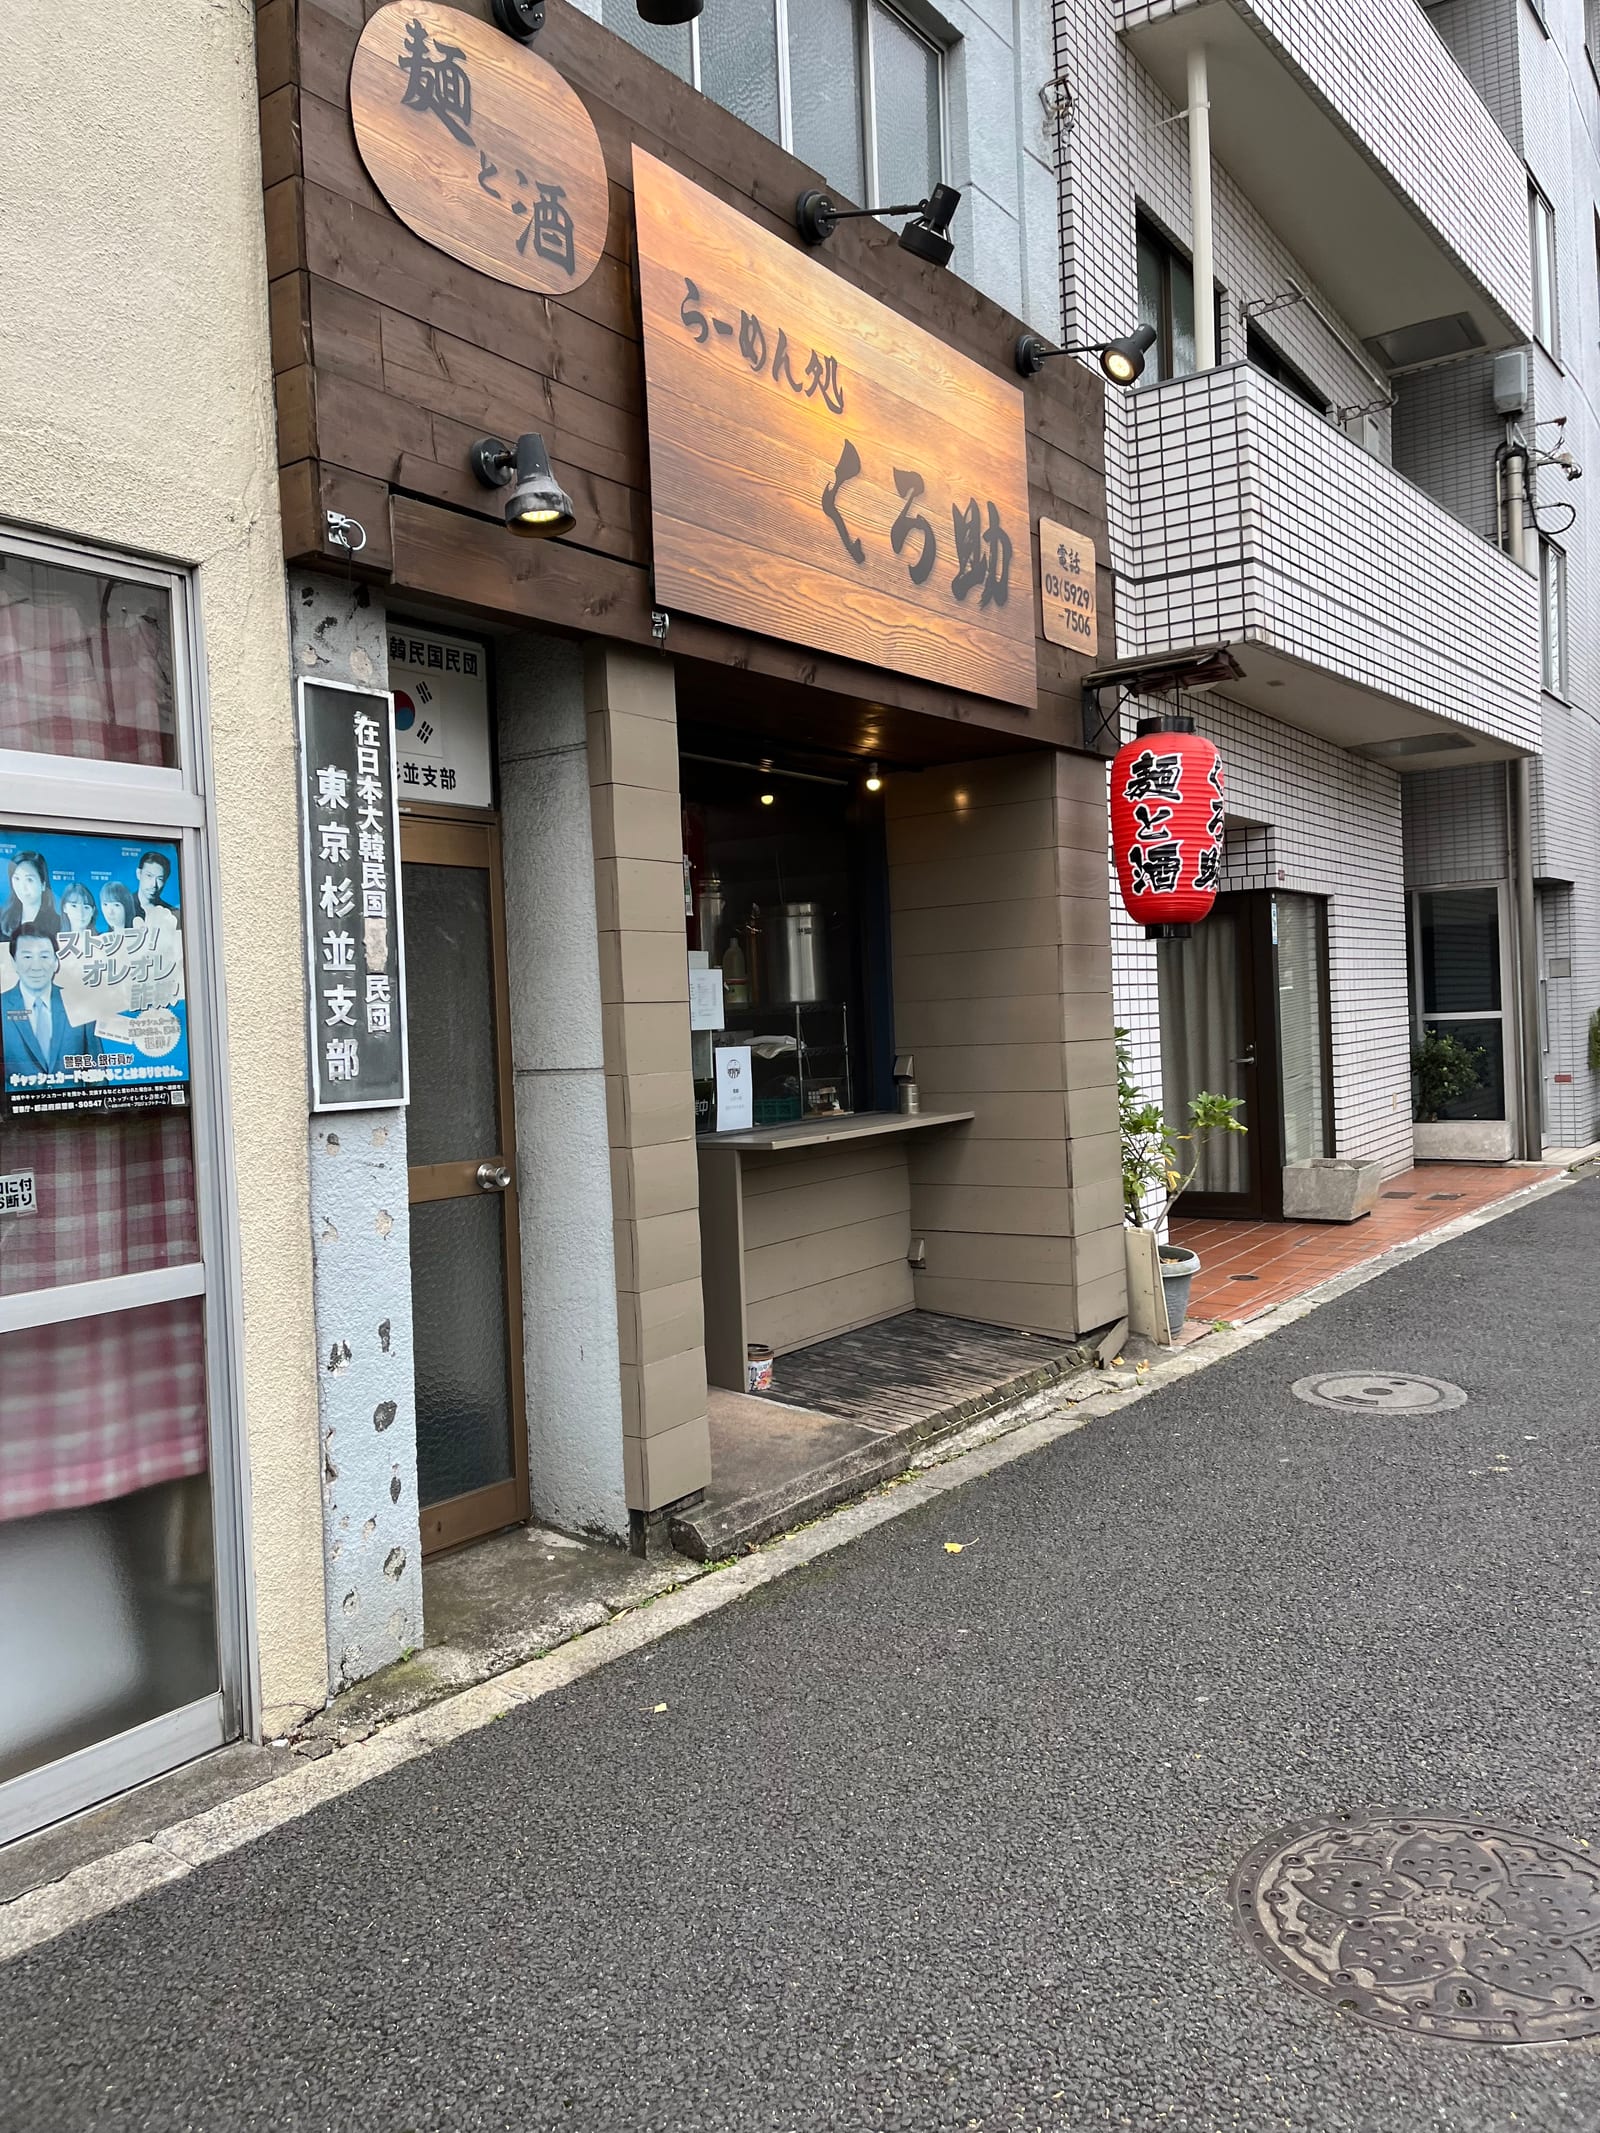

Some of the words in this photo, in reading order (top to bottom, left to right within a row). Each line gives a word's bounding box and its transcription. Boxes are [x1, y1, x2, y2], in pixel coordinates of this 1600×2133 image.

[398, 18, 576, 277] 麺と酒
[680, 277, 844, 414] らーめん処
[821, 438, 1013, 609] くろ助
[1057, 544, 1081, 575] 電話
[1045, 573, 1095, 613] 03(5929)
[1058, 608, 1091, 637] -7506
[396, 761, 456, 790] 並支部
[353, 711, 387, 919] 在日本大韓民国
[1123, 750, 1184, 895] 麺と酒
[316, 765, 359, 1081] 東京杉並支部
[82, 955, 177, 988] オレオレ
[365, 973, 392, 1033] 民団
[10, 1065, 183, 1087] キャッシュカードることはありません。
